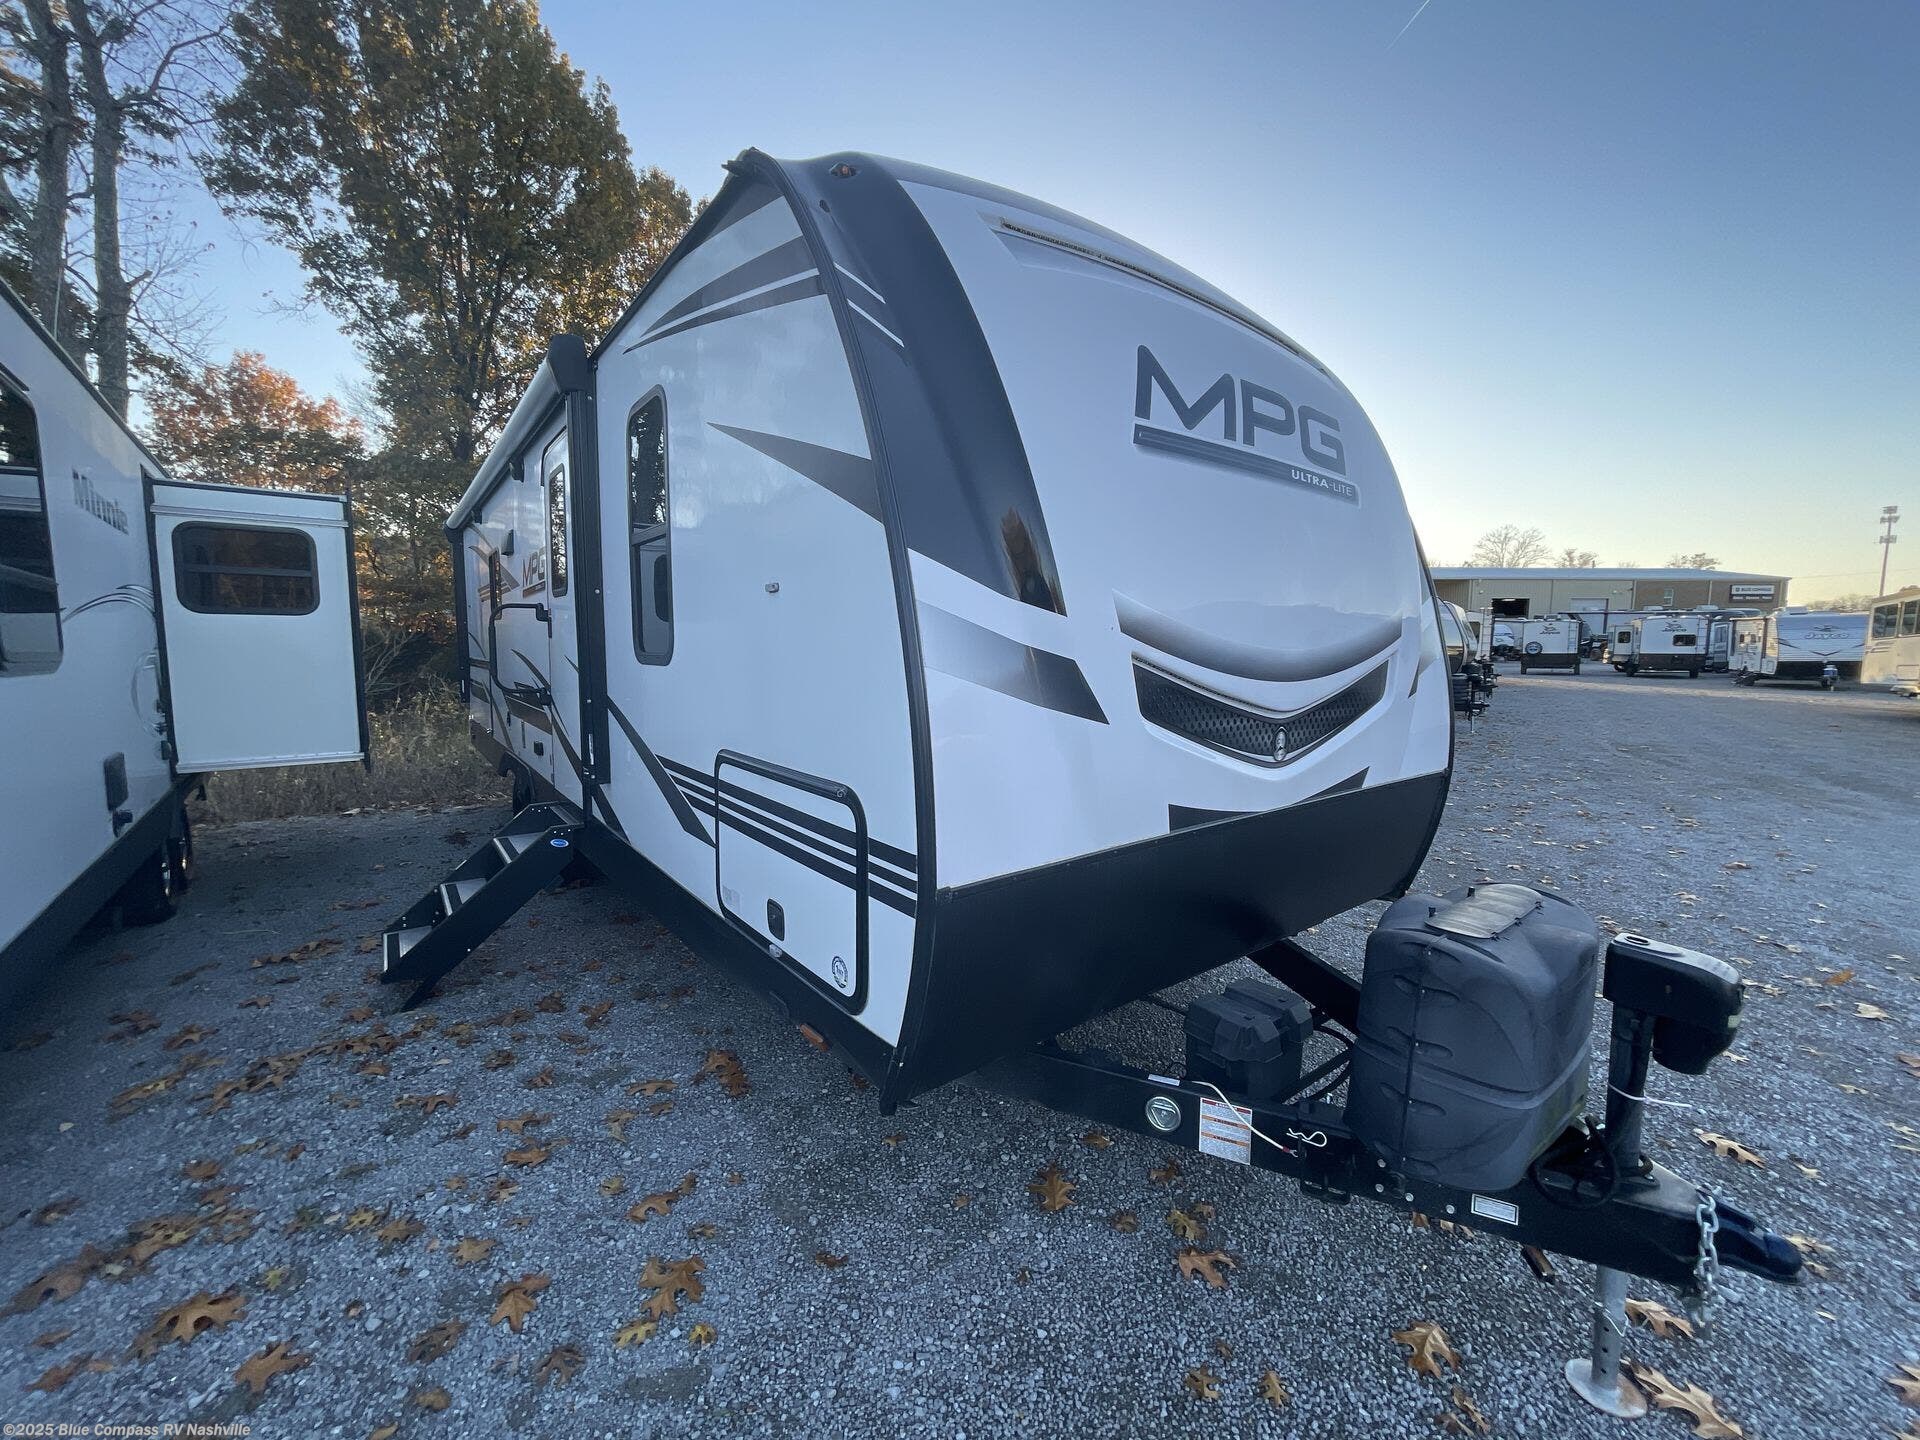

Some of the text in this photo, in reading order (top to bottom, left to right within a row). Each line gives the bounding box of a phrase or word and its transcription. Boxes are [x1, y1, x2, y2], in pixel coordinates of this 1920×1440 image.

[1134, 344, 1346, 476] MPG
[1291, 469, 1353, 497] ULTRA-LITE
[522, 547, 546, 588] MPG
